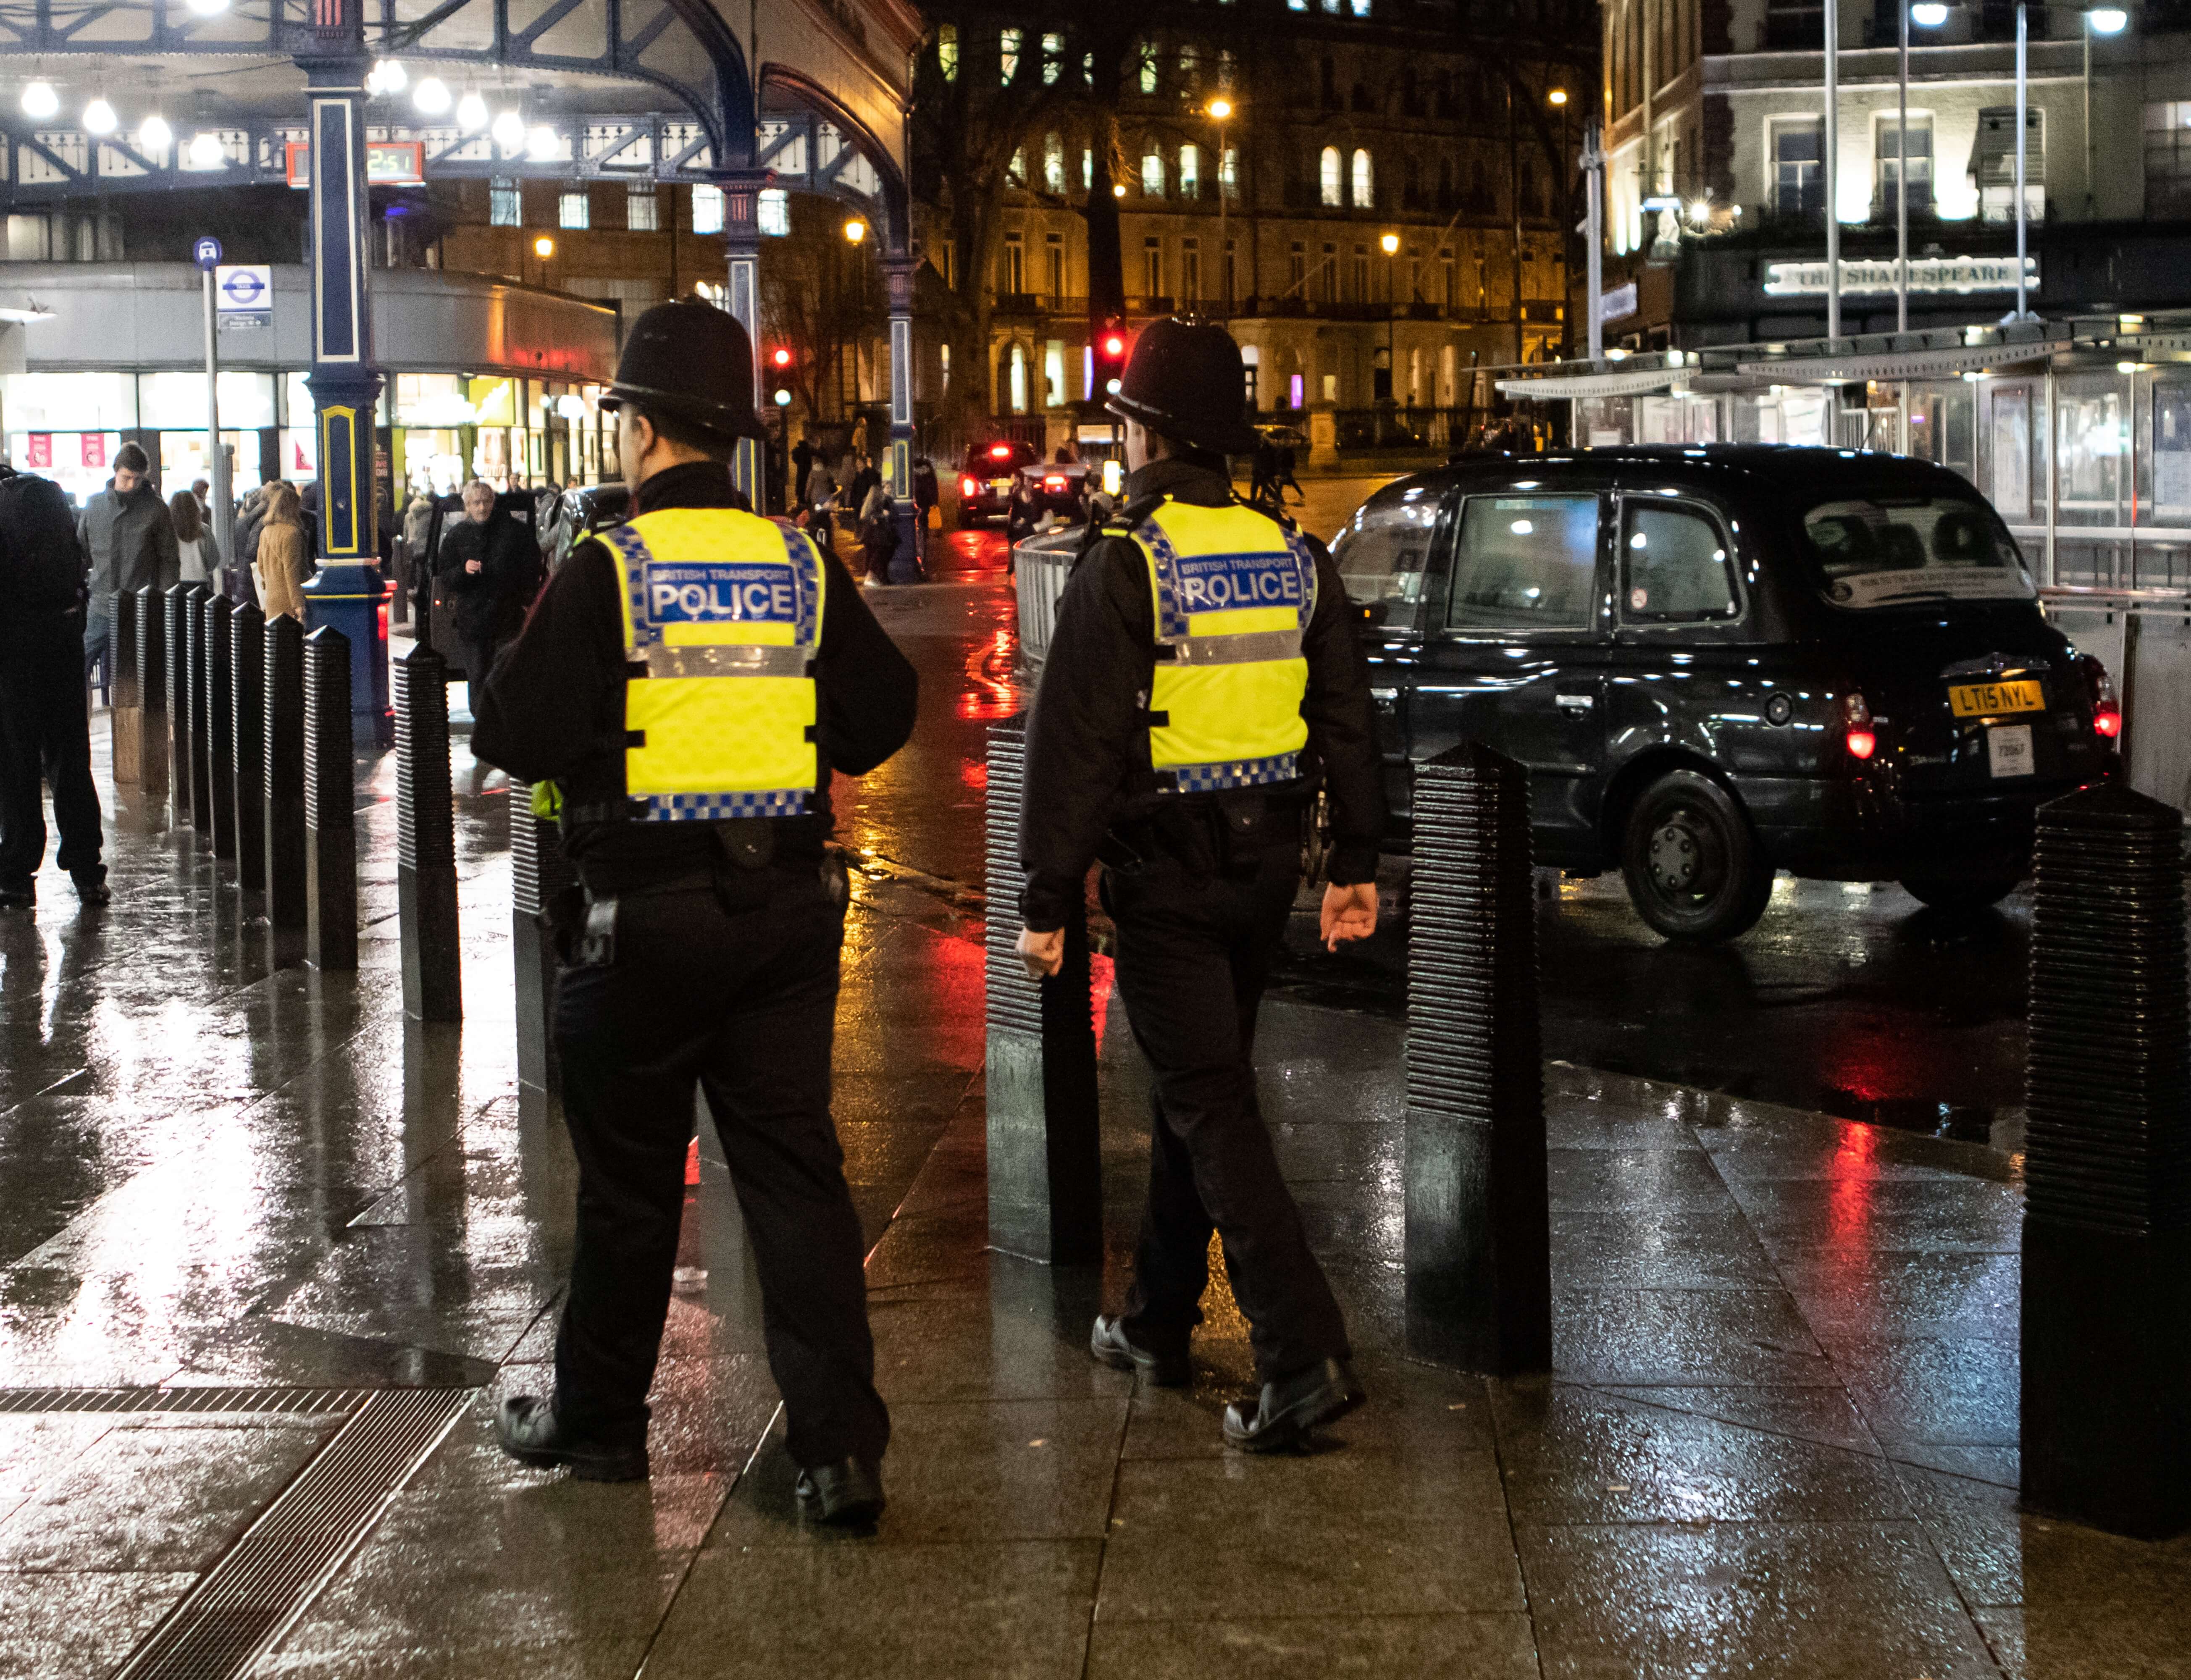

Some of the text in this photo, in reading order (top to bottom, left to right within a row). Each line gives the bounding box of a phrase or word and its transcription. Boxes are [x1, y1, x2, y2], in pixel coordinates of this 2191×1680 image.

[1181, 559, 1293, 575] BRITISH TRANSPORT
[652, 584, 794, 617] POLICE
[1184, 572, 1299, 606] POLICE
